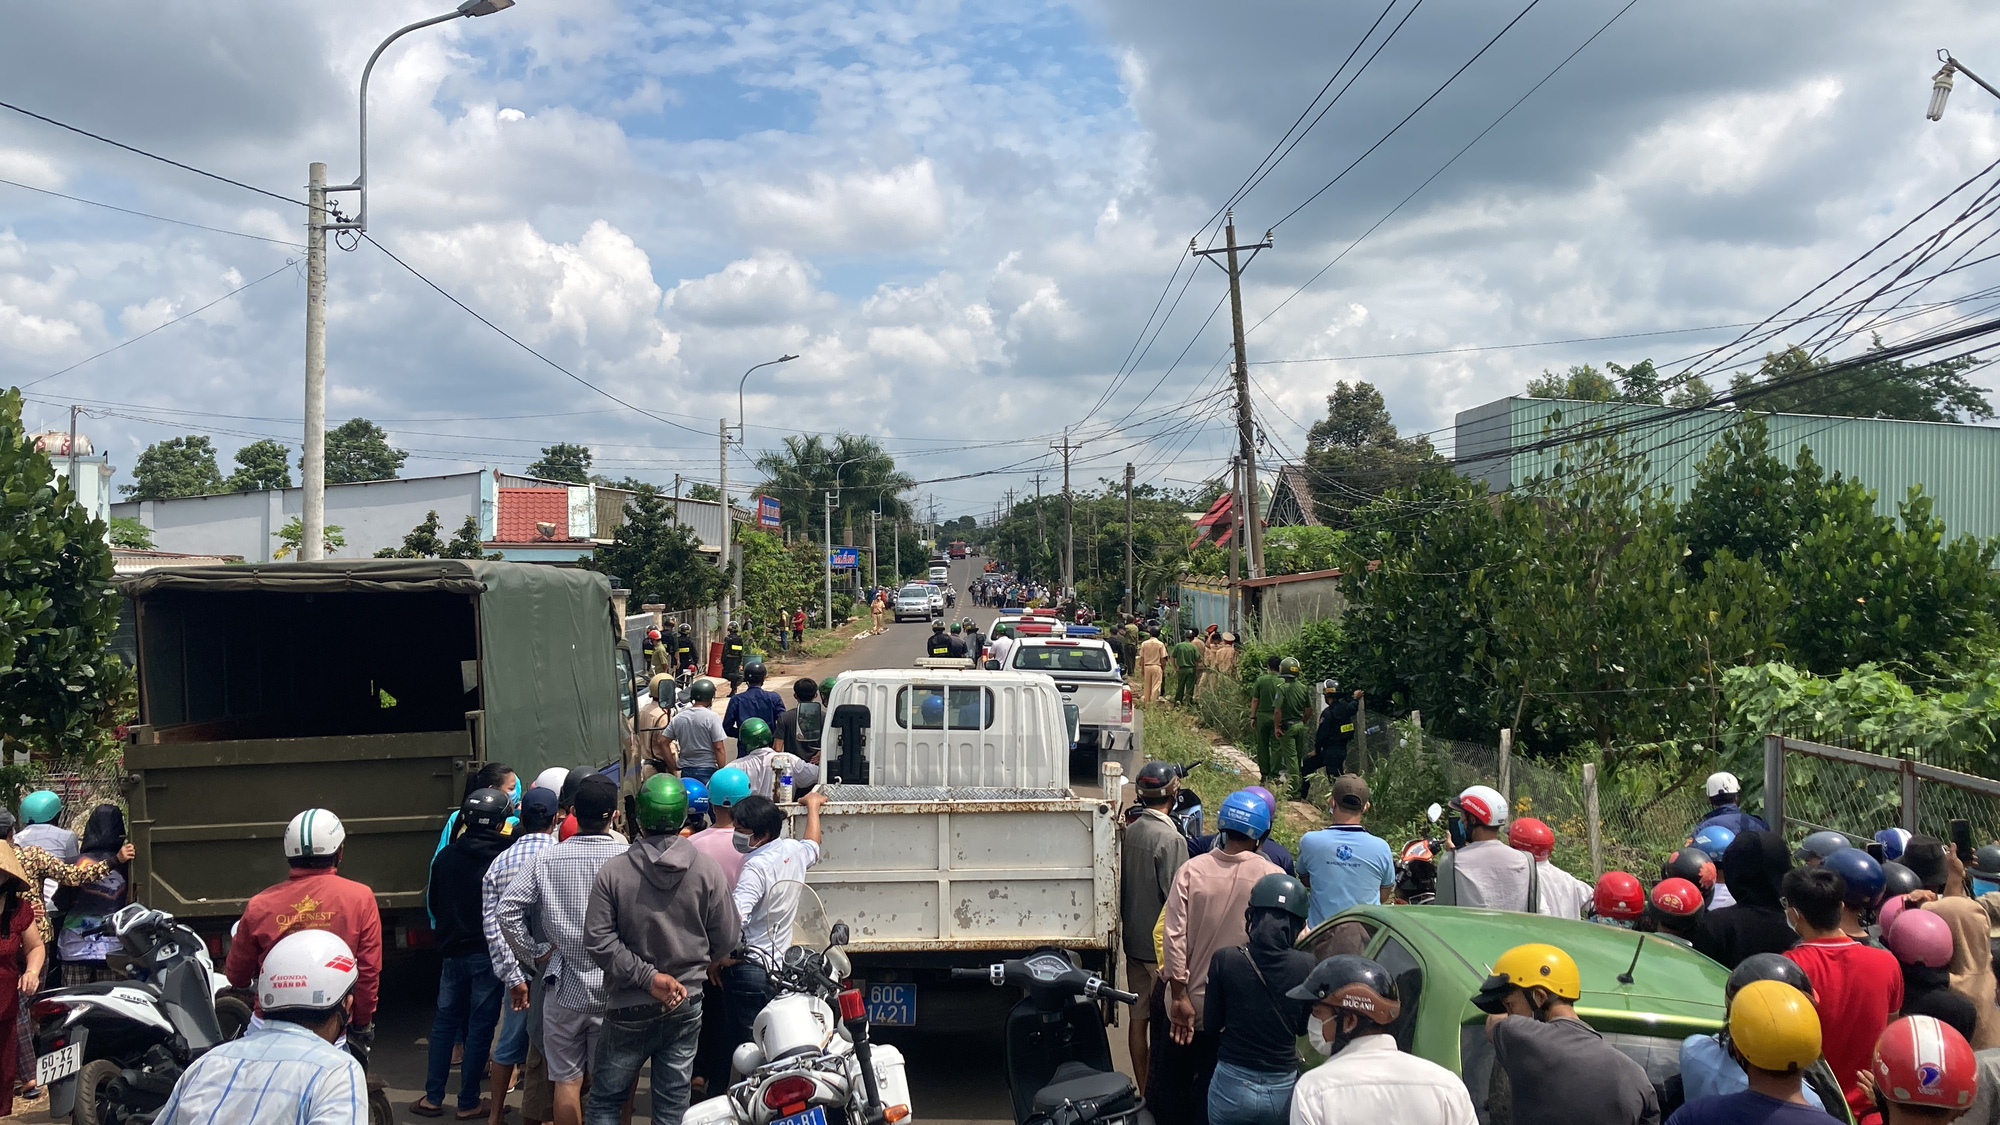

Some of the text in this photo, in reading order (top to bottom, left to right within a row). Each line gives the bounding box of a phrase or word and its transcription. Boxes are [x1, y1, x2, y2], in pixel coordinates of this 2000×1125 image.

[272, 981, 294, 989] XUÂN
[120, 993, 148, 1005] CLICK
[871, 985, 904, 1004] 60C
[1345, 994, 1371, 1003] HONDA
[867, 1004, 907, 1024] 1421
[1360, 1001, 1375, 1012] ANH
[42, 1046, 73, 1070] 60-X2
[42, 1060, 73, 1085] 7777
